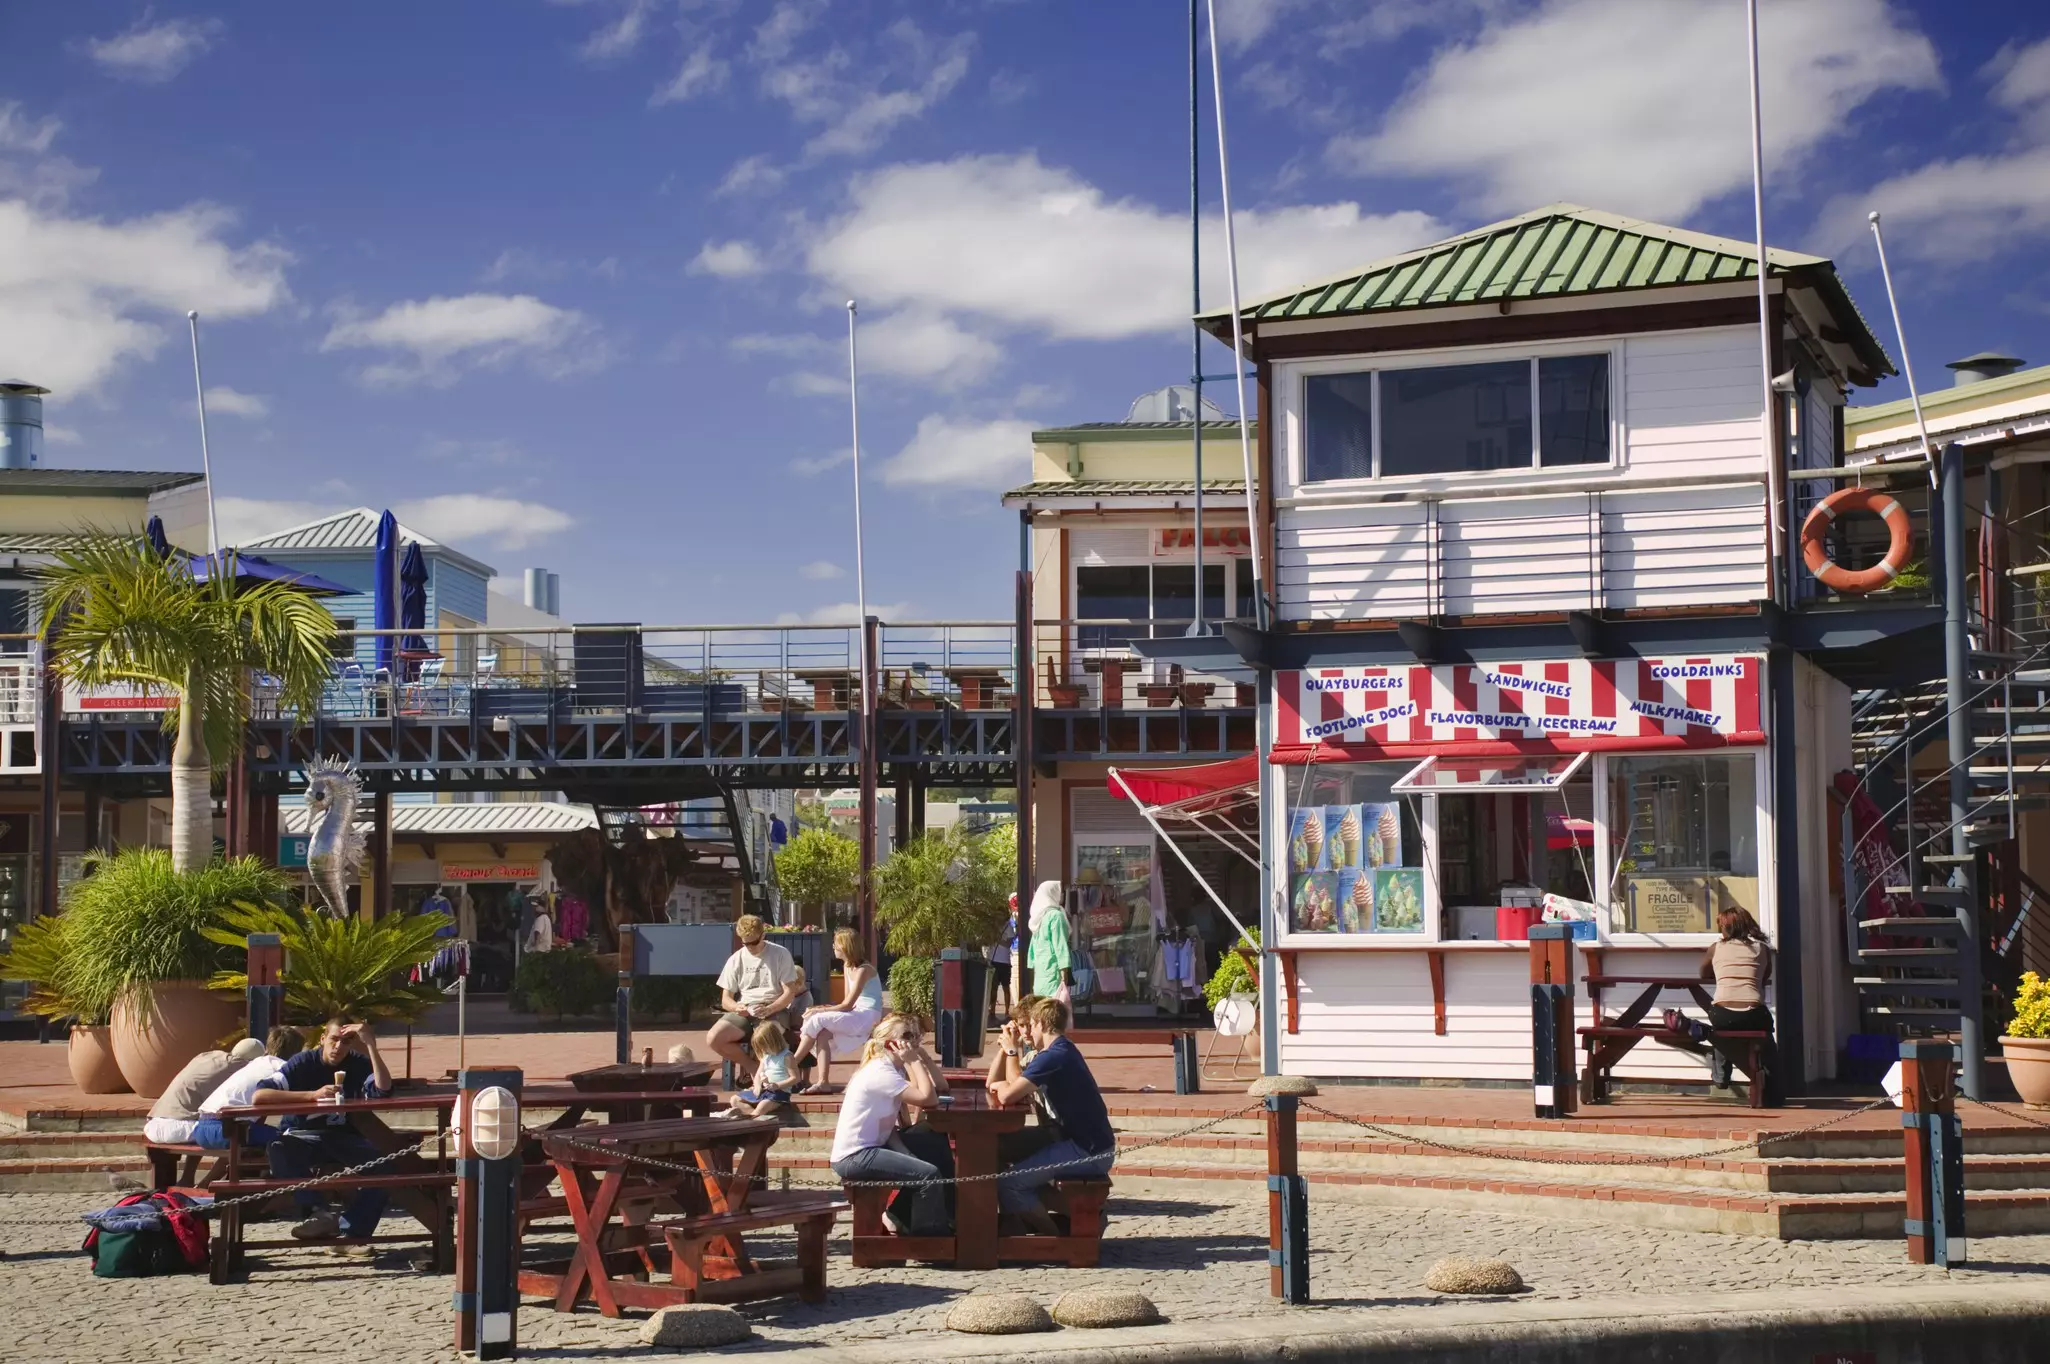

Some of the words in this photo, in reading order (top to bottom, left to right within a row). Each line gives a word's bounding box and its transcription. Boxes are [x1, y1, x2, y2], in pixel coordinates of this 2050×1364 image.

[1652, 664, 1742, 678] COOLDRINKS
[1305, 677, 1403, 691] QUAYBURGERS
[1486, 673, 1572, 697] SANDWICHES
[103, 699, 134, 707] GREEK
[1305, 713, 1374, 738] FOOTLONG
[1379, 703, 1414, 721] DOGS
[1430, 712, 1531, 728] FLAVORBURST
[1537, 717, 1617, 731] ICECREAMS
[1629, 701, 1722, 726] MILKSHAKES
[1647, 893, 1694, 904] FRAGILE
